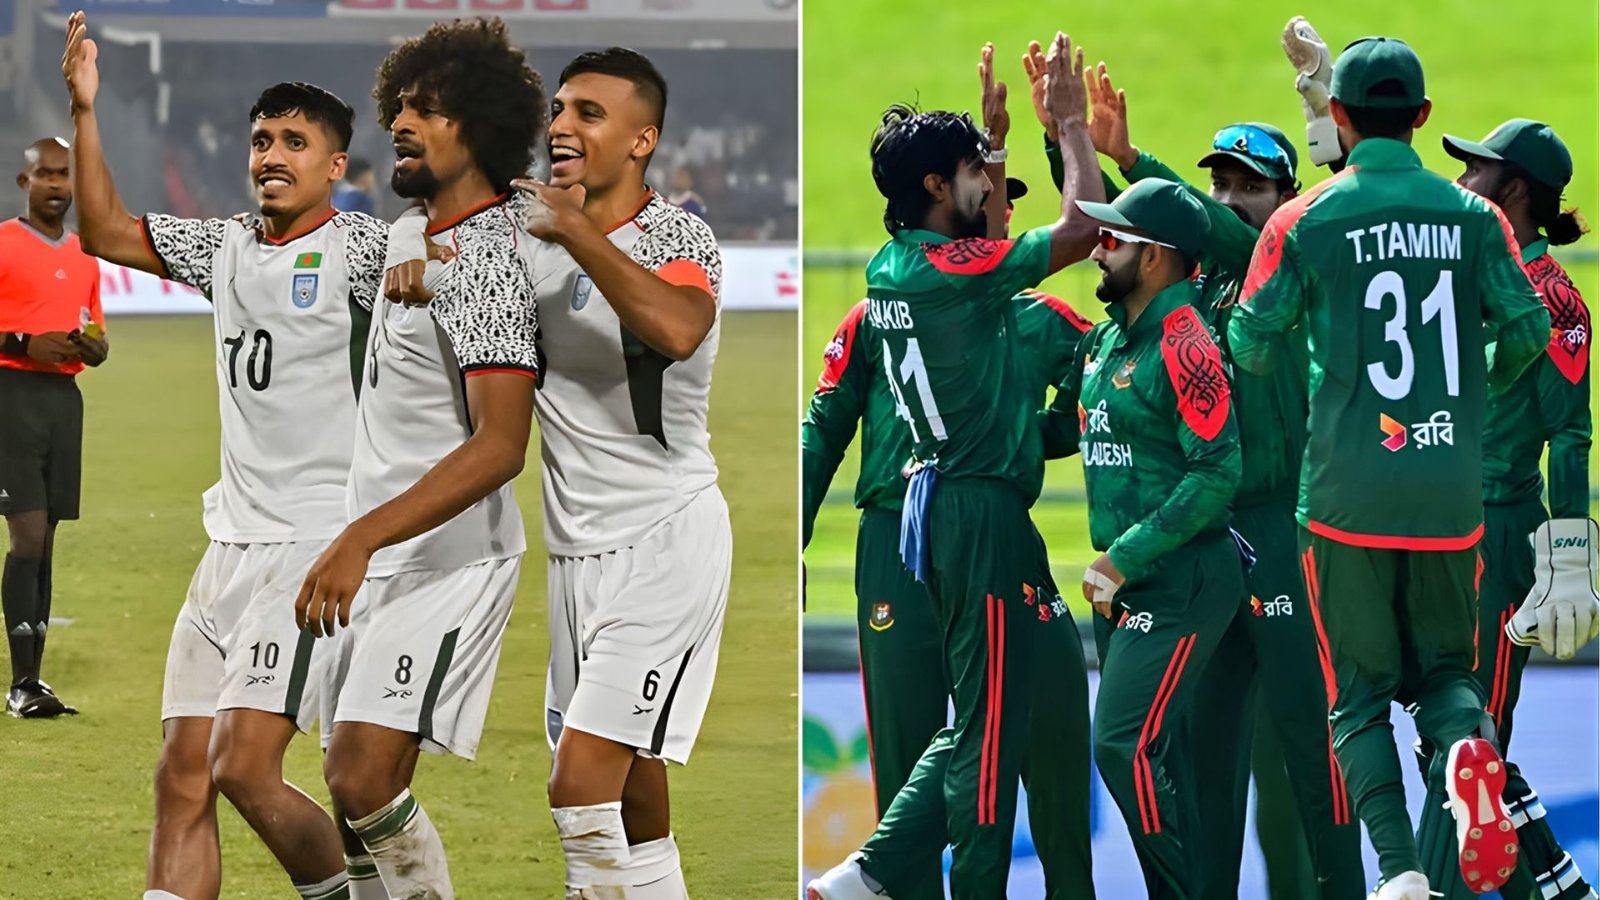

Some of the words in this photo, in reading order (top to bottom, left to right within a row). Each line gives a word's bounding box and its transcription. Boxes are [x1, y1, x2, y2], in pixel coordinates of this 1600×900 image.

[1346, 221, 1462, 264] T.TAMIM
[1364, 270, 1460, 400] 31
[224, 329, 272, 391] 10
[1411, 411, 1454, 450] রবি
[1125, 611, 1154, 634] রবি
[1263, 595, 1293, 617] রবি
[250, 641, 280, 670] 10
[394, 655, 413, 686] 8
[642, 669, 661, 702] 6
